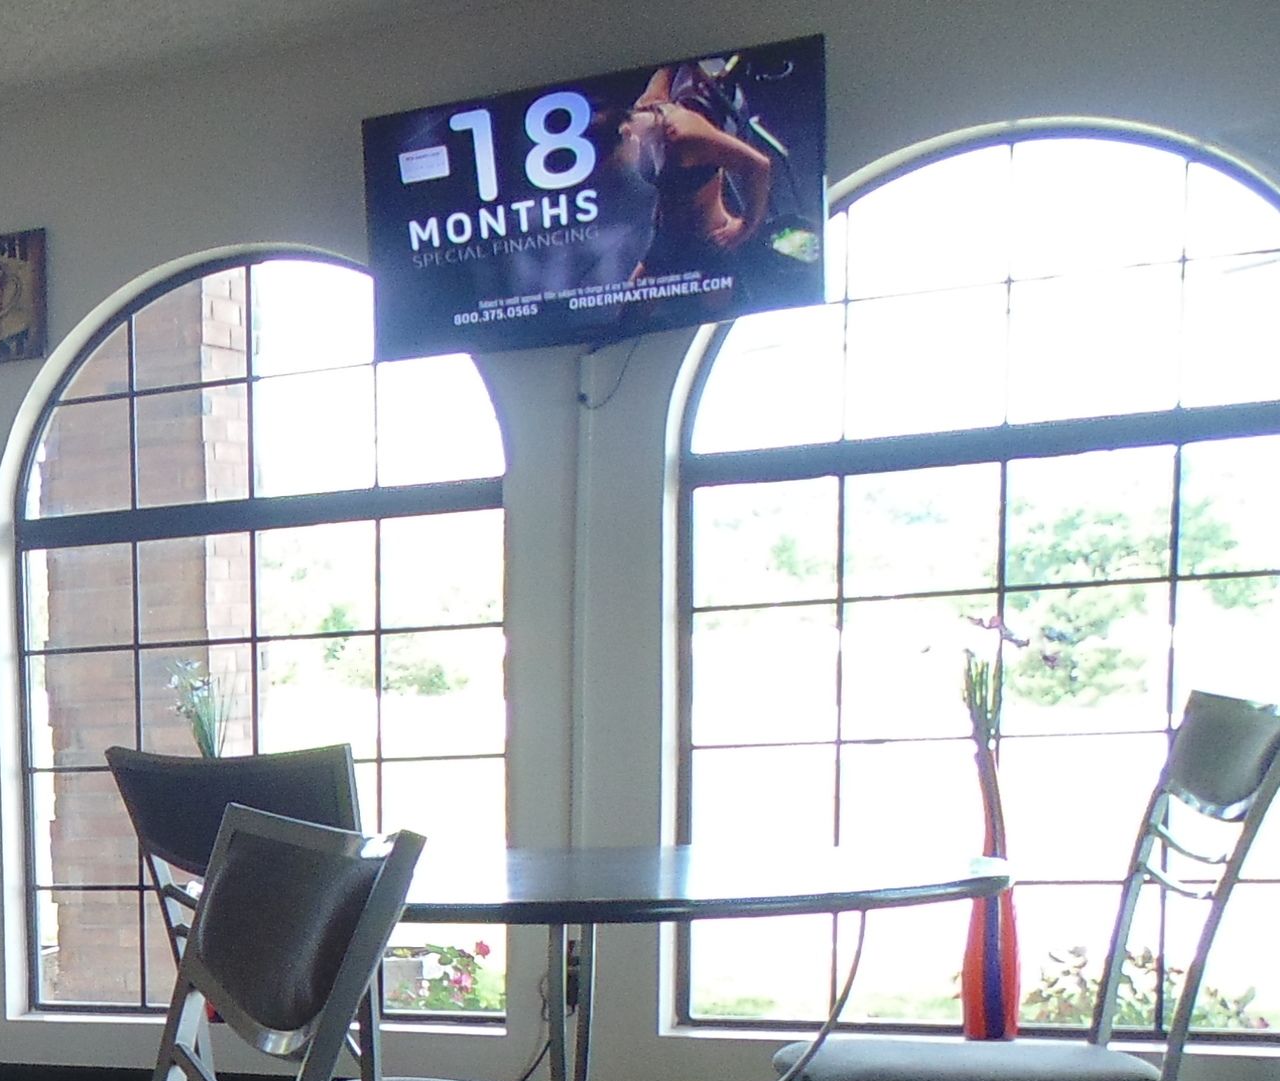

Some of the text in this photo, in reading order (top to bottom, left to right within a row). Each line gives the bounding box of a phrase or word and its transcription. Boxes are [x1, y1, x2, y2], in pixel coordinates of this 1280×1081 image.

[449, 91, 597, 202] 18
[408, 189, 599, 252] MONTHS
[412, 225, 599, 269] SPECIAL FINANCING
[568, 276, 733, 310] ORDERMAXTRAINER.COM
